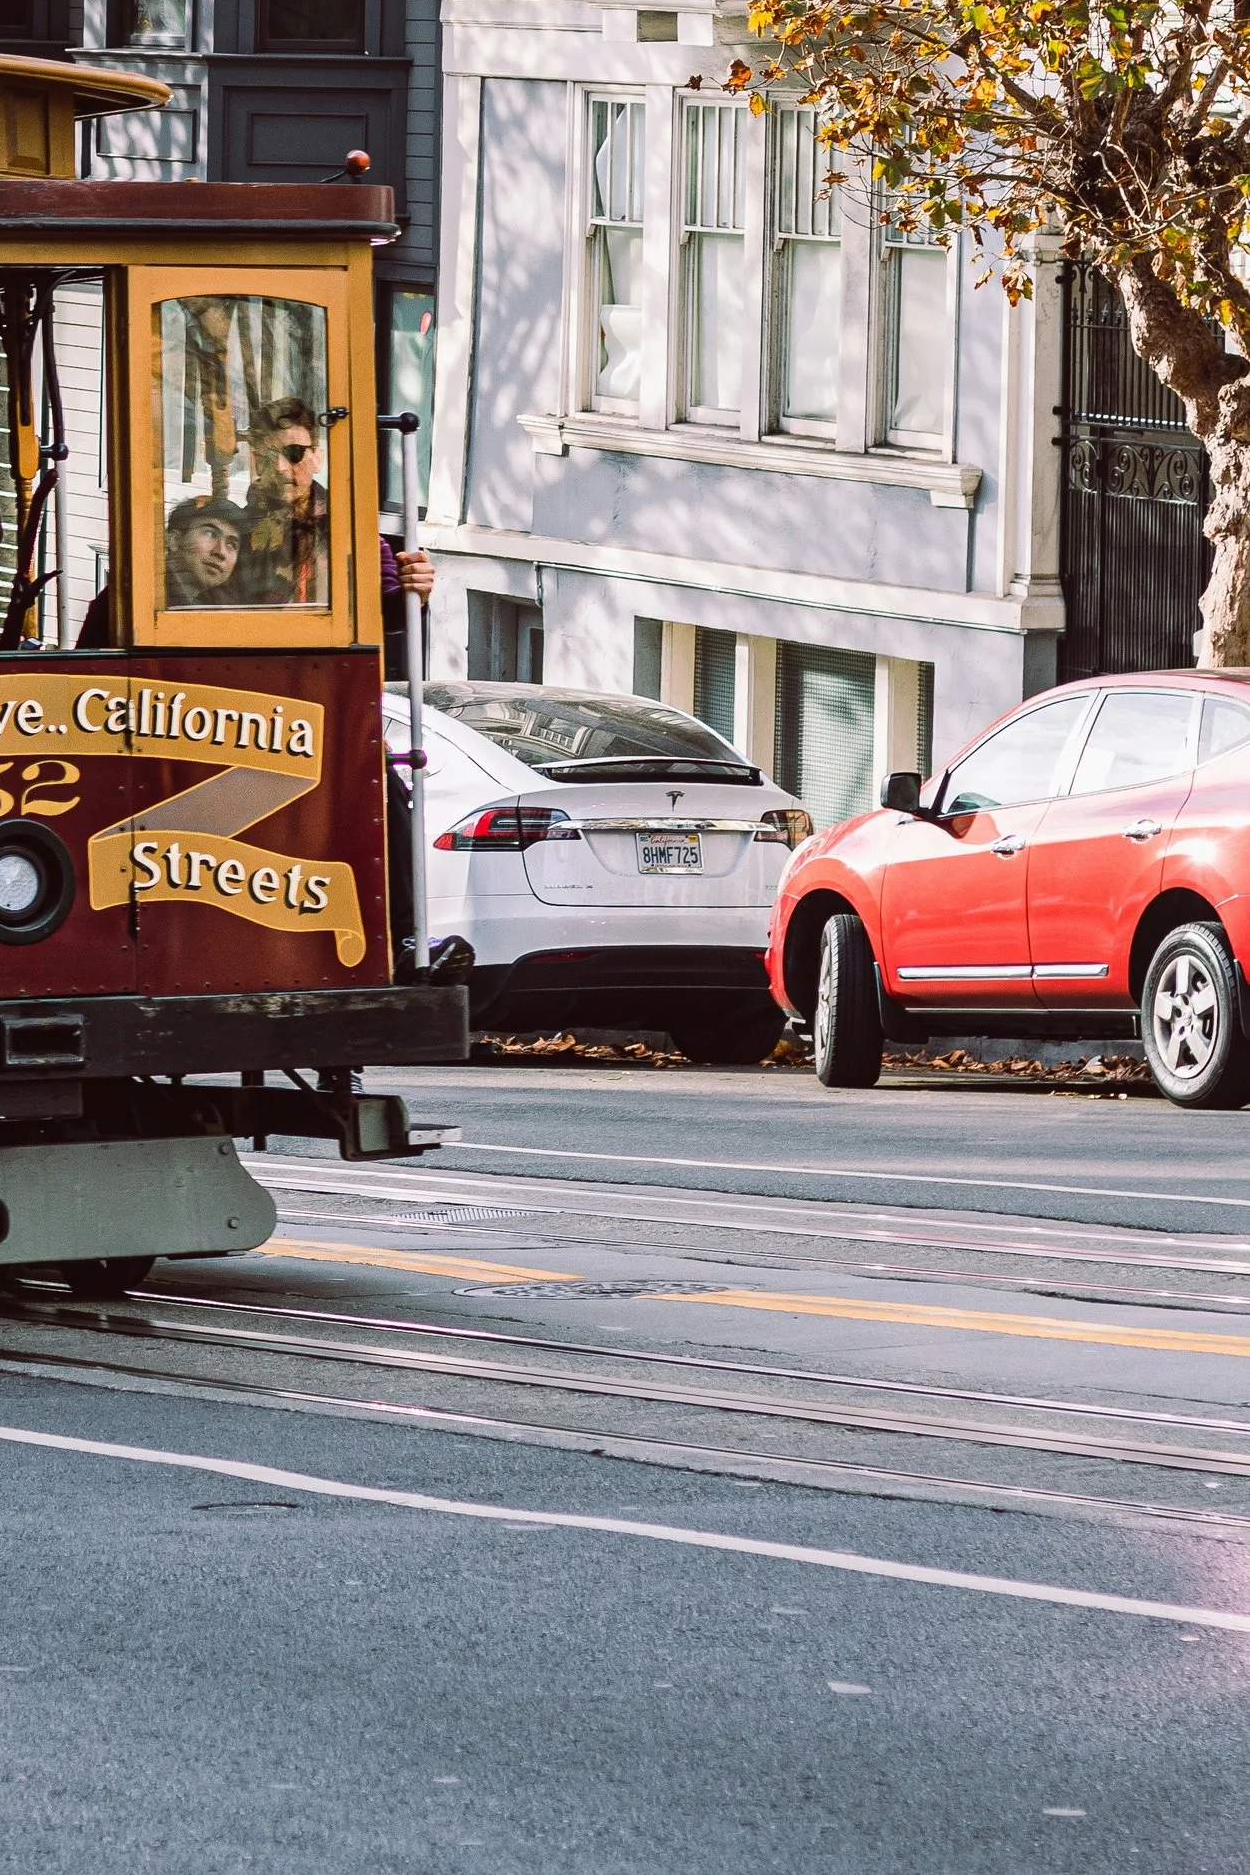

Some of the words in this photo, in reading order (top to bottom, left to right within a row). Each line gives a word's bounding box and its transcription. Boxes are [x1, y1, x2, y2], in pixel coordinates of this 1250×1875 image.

[73, 687, 315, 759] California
[129, 841, 331, 915] Streets
[642, 846, 699, 864] 8HMF725
